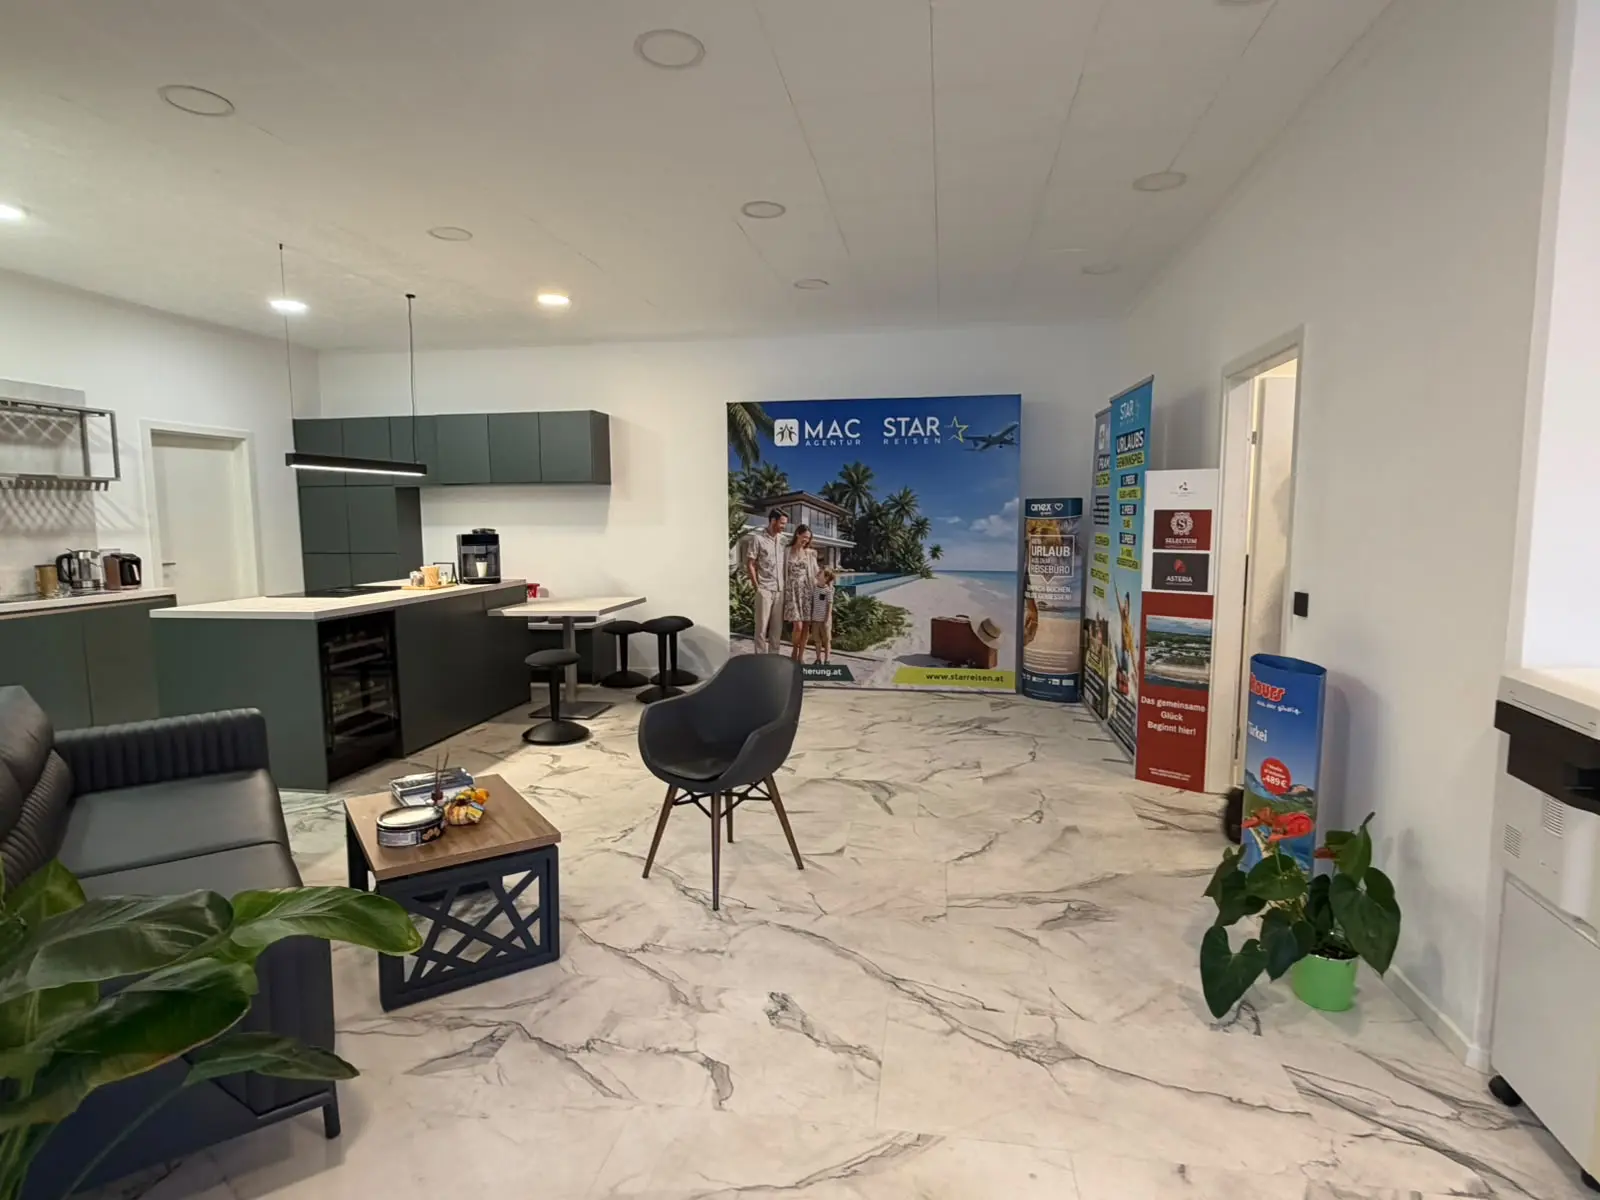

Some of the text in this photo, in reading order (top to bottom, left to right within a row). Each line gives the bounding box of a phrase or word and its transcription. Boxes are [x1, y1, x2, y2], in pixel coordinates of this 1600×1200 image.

[804, 418, 861, 438] MAC
[883, 416, 941, 437] STAR
[805, 439, 861, 447] AGENTUR
[883, 437, 941, 445] REISEN
[1030, 503, 1052, 512] anex
[1165, 537, 1198, 545] SELECTUM
[1031, 546, 1070, 557] URLAUB
[1031, 564, 1070, 574] REISEBÜRO
[1165, 575, 1193, 583] ASTERIA
[802, 667, 842, 677] herung.at
[925, 671, 1004, 683] www.starreisen.at
[1140, 695, 1206, 713] Das gemeinsame
[1160, 710, 1184, 722] Glück
[1147, 720, 1197, 737] Beginnt hier!
